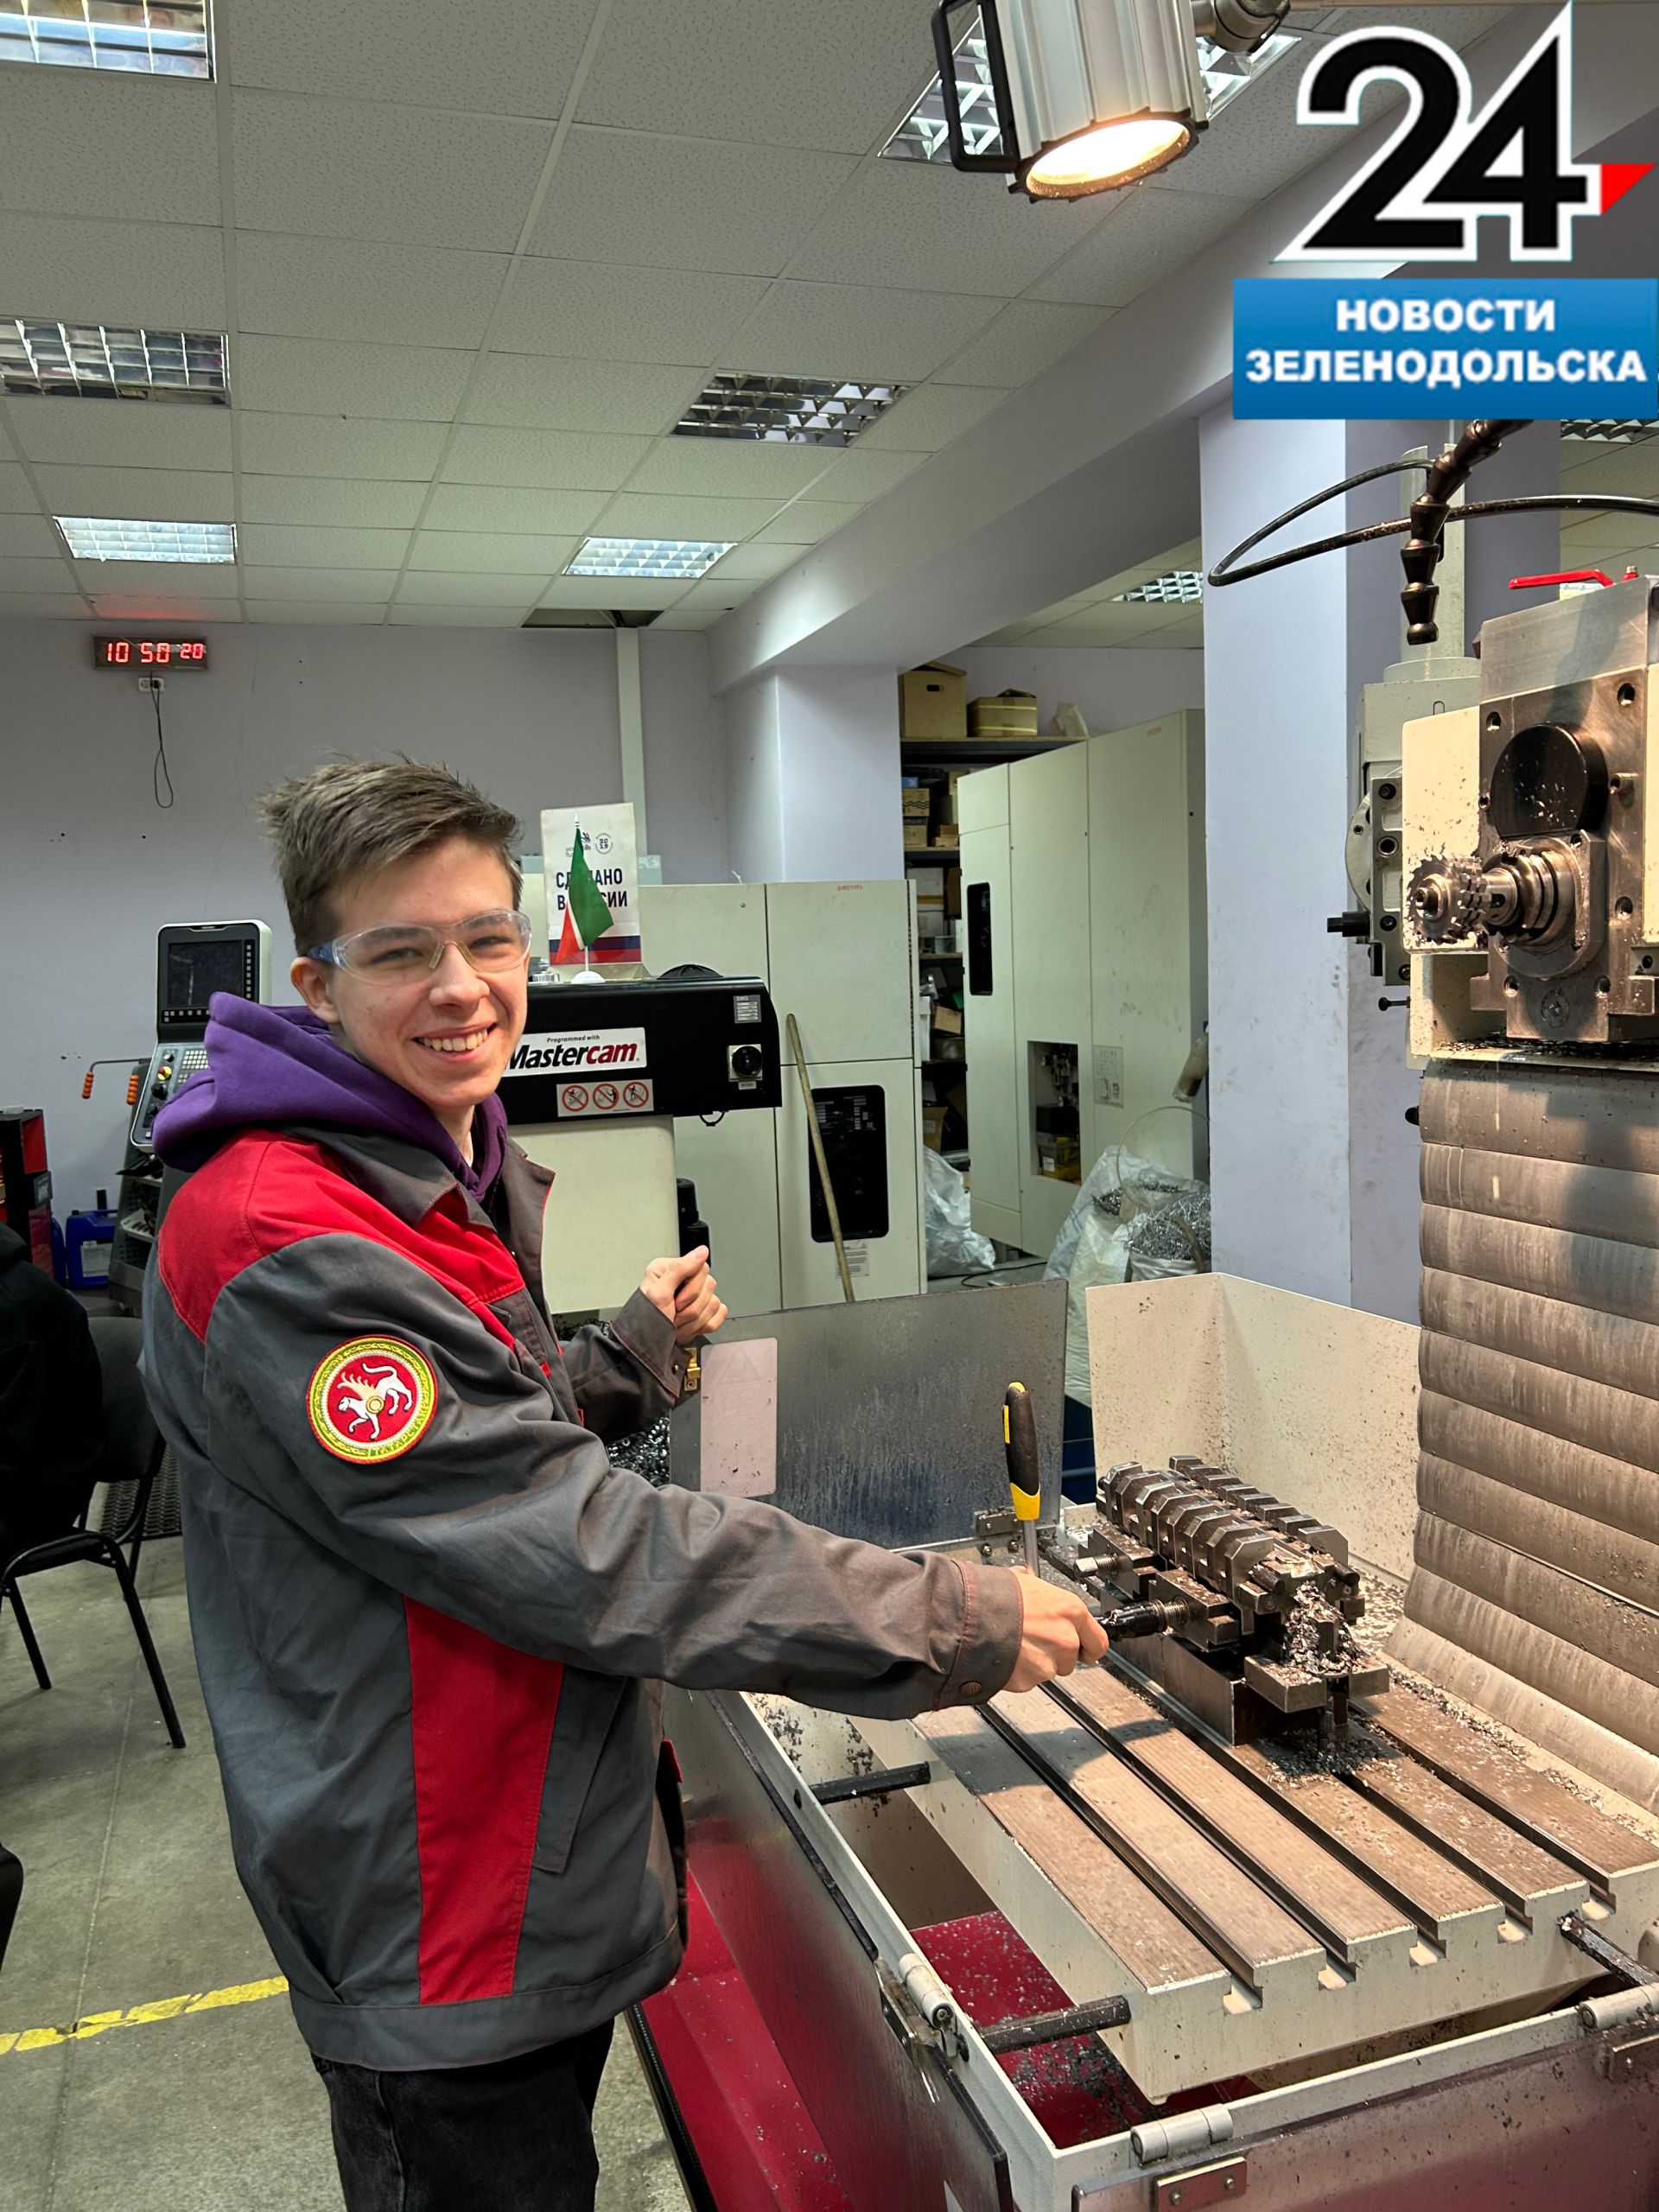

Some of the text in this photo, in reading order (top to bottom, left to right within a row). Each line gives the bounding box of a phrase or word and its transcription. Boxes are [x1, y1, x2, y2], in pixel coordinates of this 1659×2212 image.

[106, 641, 205, 664] 10 50 20
[508, 1043, 638, 1070] Mastercam
